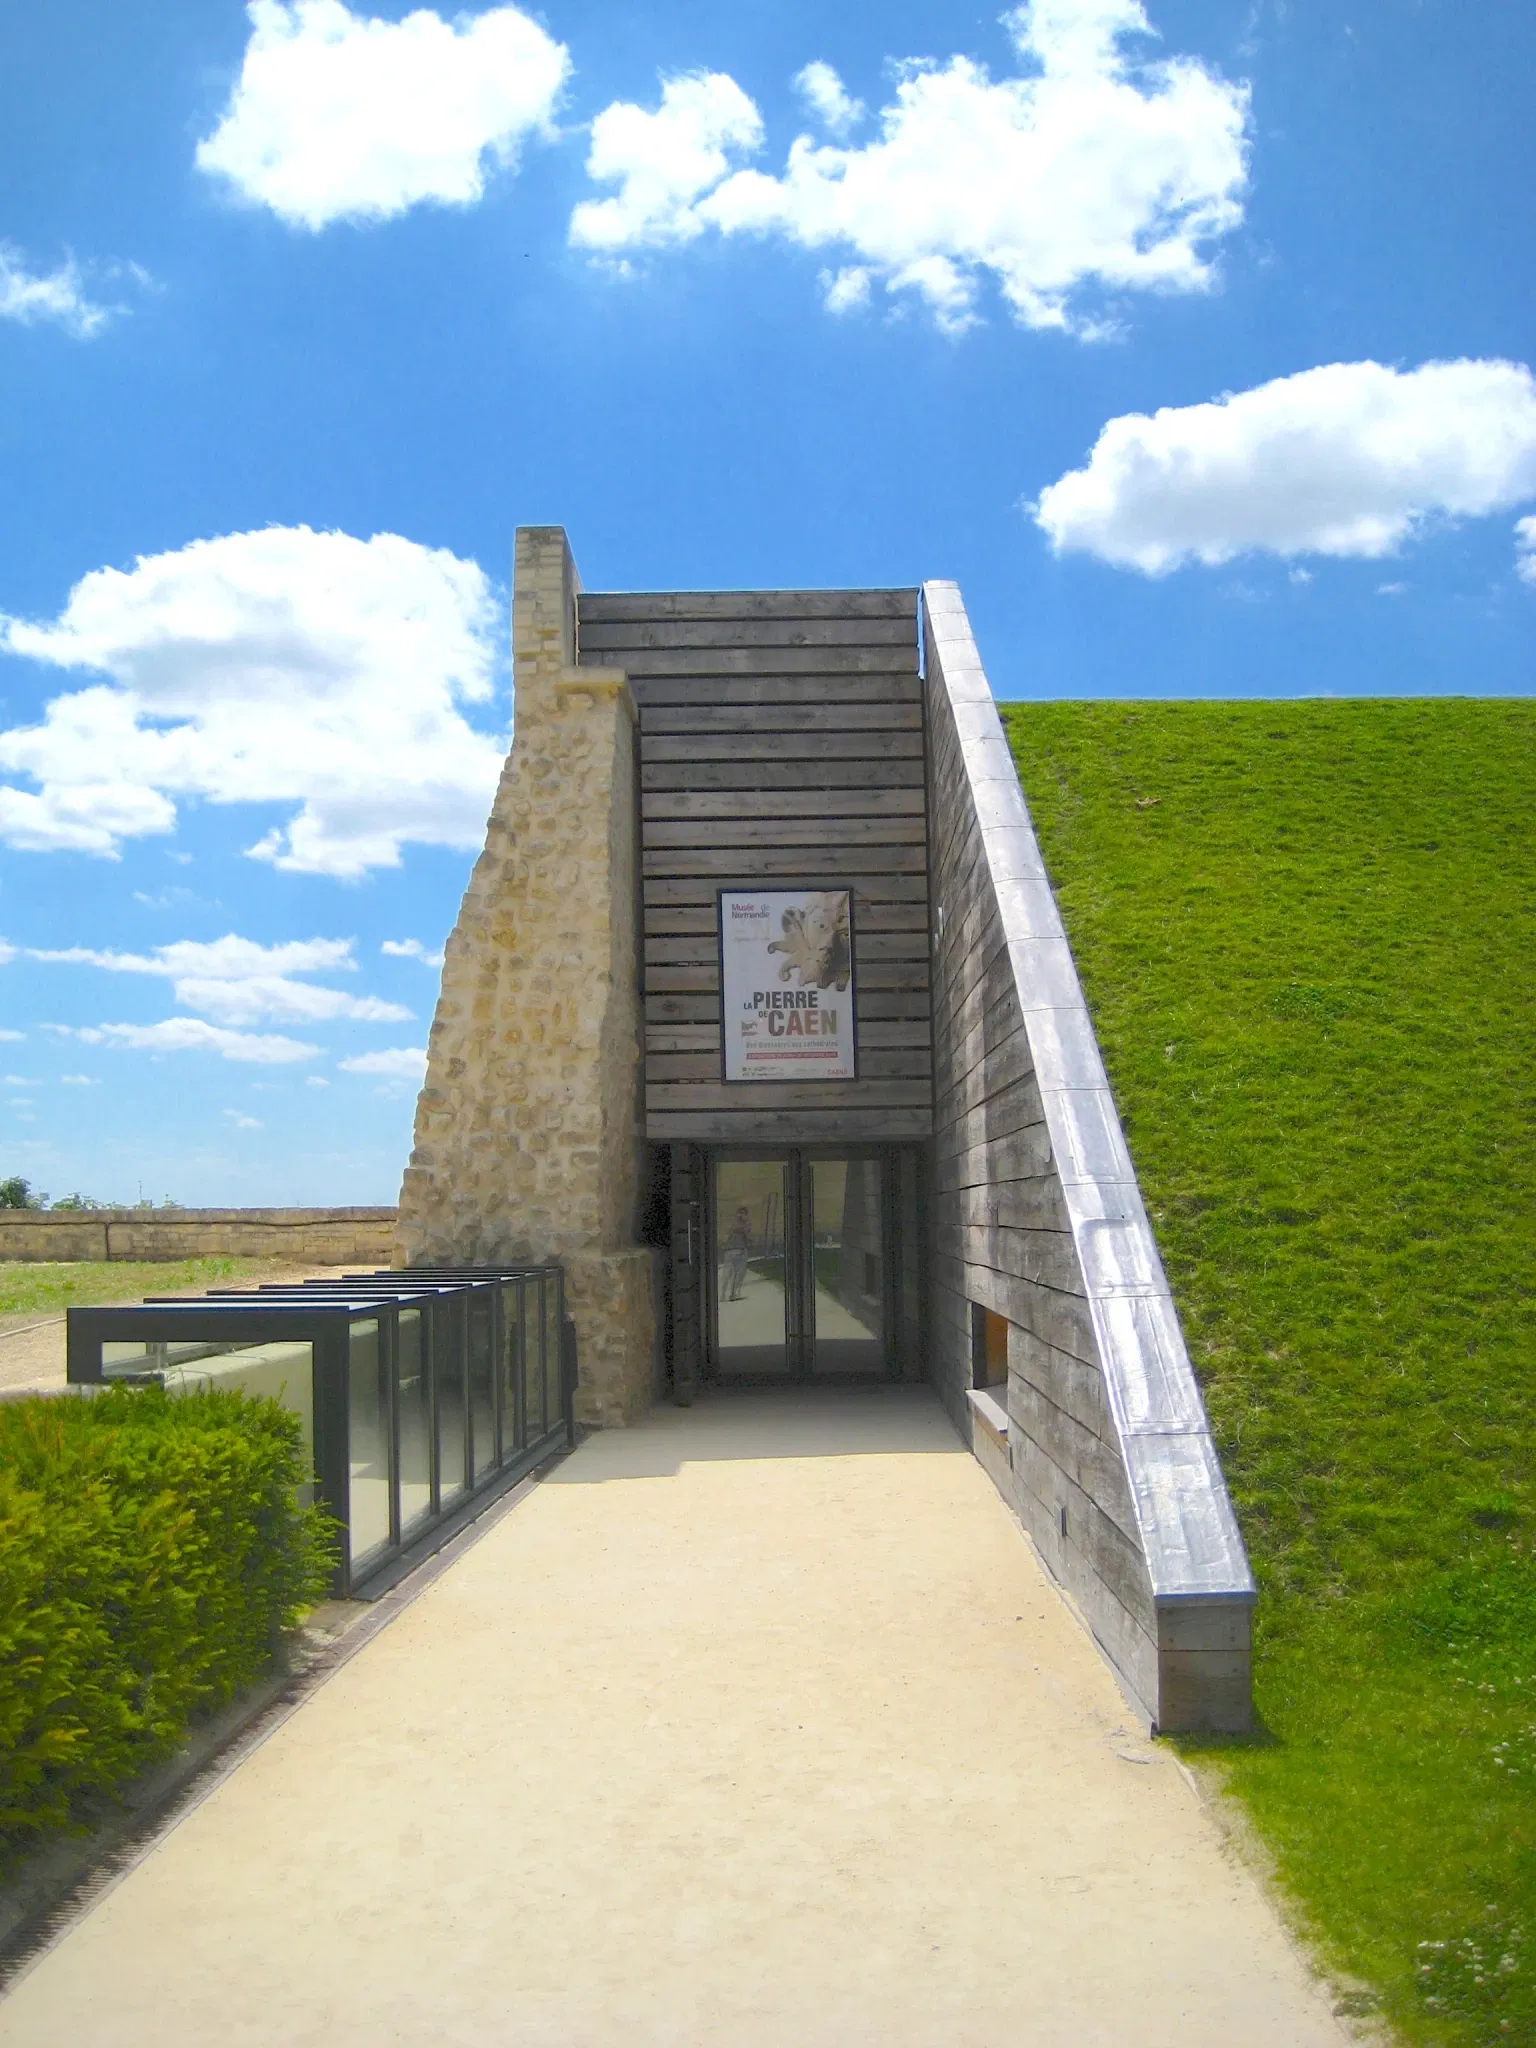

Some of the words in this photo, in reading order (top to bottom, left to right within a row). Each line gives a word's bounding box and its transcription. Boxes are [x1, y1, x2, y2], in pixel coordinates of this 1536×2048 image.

[744, 1002, 753, 1010] LA
[753, 991, 818, 1009] PIERRE
[768, 1010, 836, 1036] CAEN
